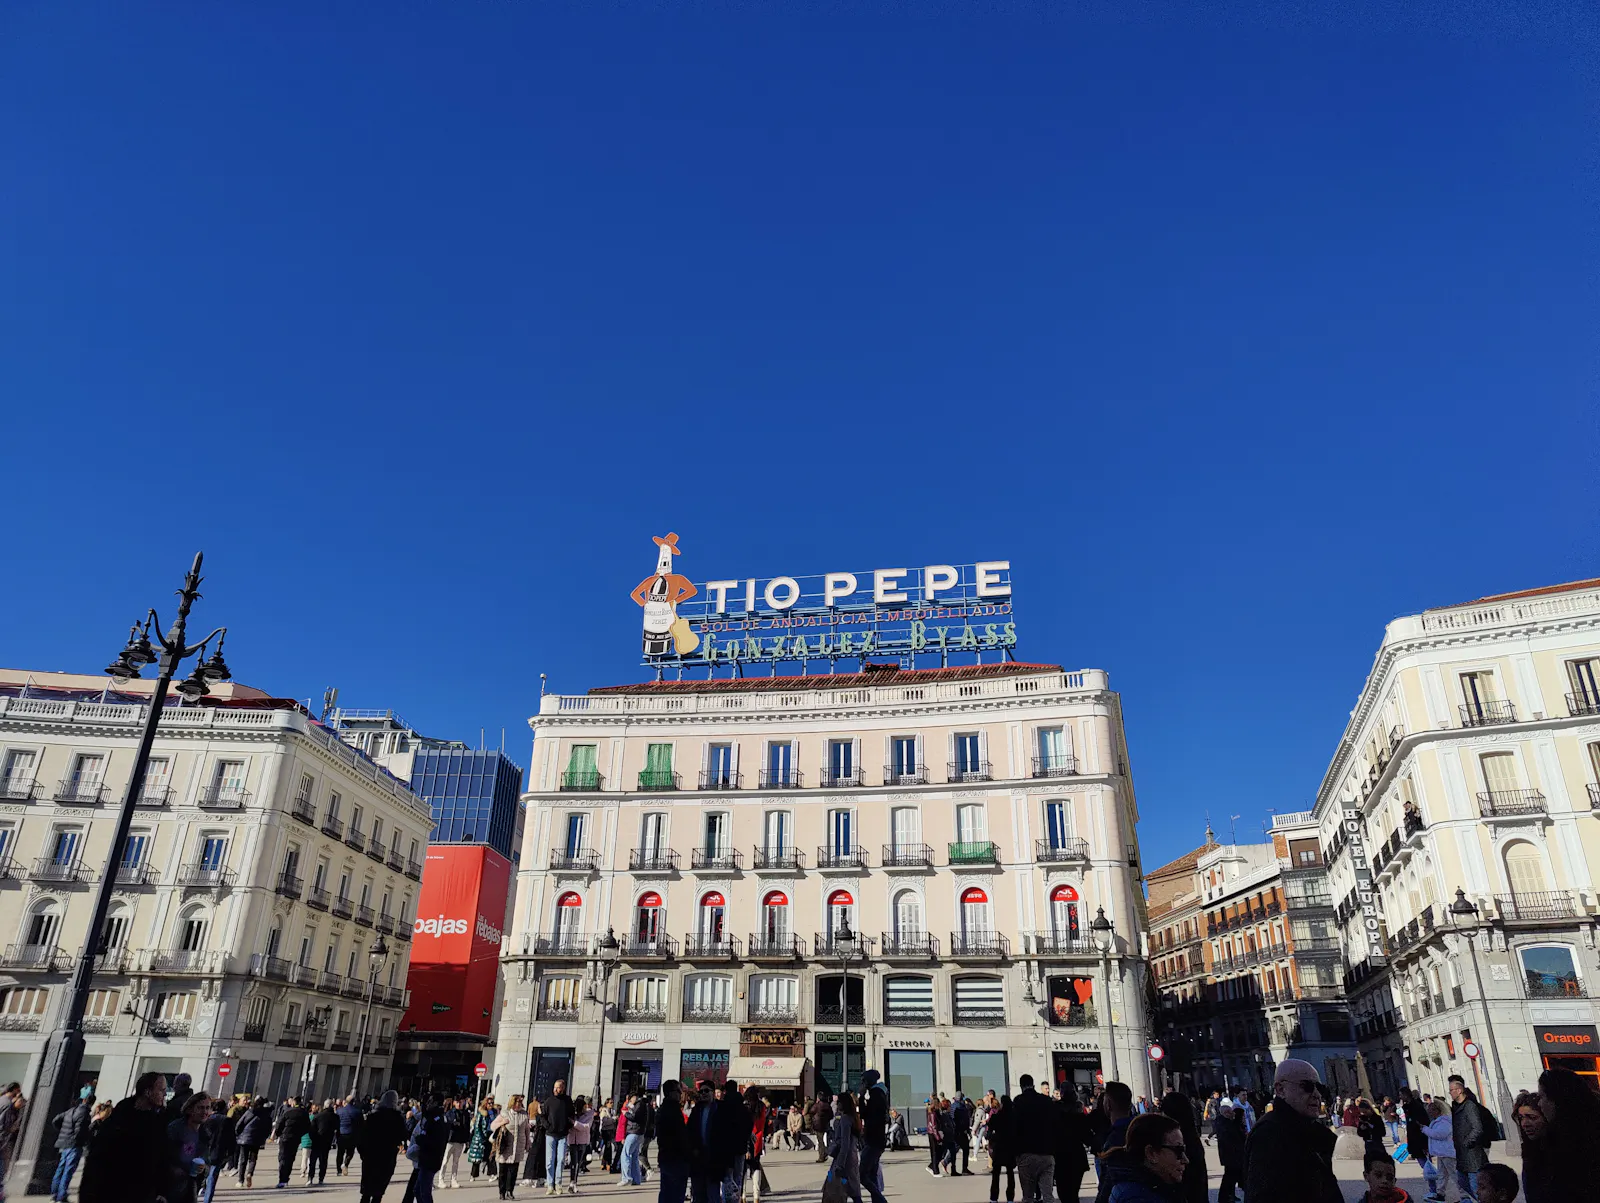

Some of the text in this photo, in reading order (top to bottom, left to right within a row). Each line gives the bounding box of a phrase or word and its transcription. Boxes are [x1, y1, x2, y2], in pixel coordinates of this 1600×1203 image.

[706, 560, 1012, 614] TIO PEPE
[700, 603, 1012, 633] SOL DE ANDALUCIA EMBOTELLADO
[703, 620, 1018, 662] GONZALEZ BYASS
[1343, 808, 1385, 957] HOTEL EUROPA
[475, 919, 501, 945] rebajas
[622, 1032, 658, 1041] PRIMOR
[888, 1040, 932, 1048] SEPHORA
[1053, 1042, 1100, 1050] SEPHORA
[1543, 1032, 1591, 1045] Orange
[682, 1053, 729, 1062] REBAJAS
